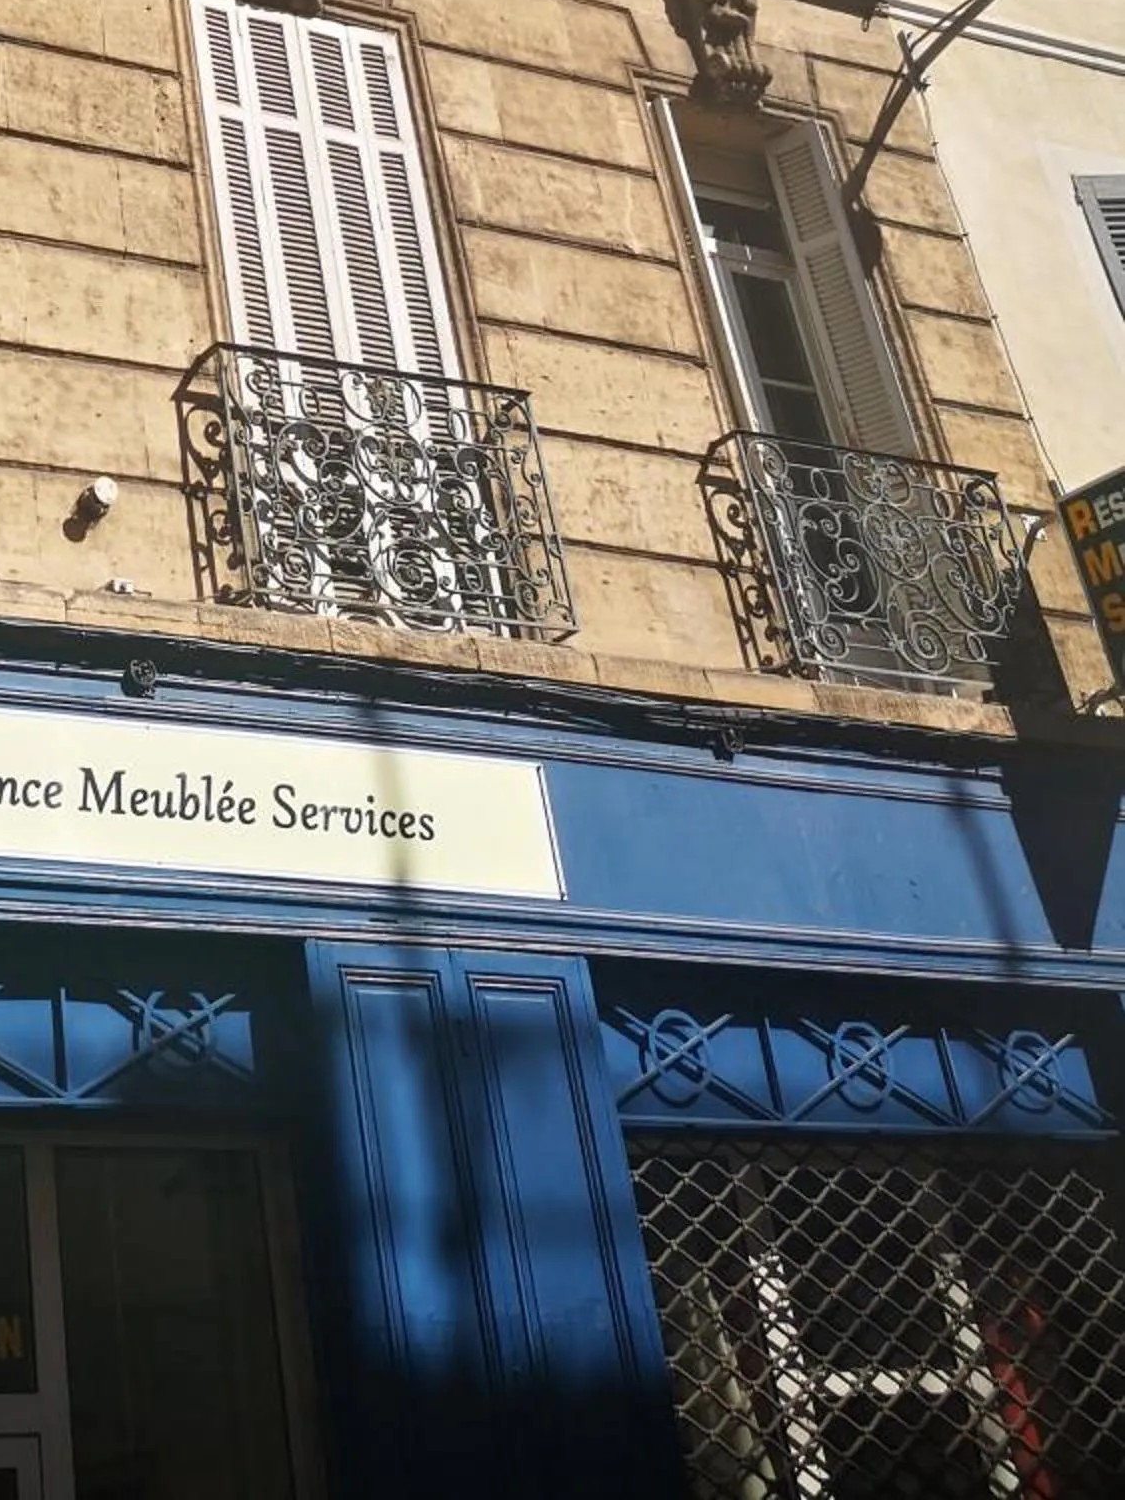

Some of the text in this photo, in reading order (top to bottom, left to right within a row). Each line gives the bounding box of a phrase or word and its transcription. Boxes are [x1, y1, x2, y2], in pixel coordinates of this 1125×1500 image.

[1066, 489, 1125, 540] RES
[1083, 540, 1125, 586] M
[78, 767, 257, 825] Meublée
[272, 784, 435, 841] Services
